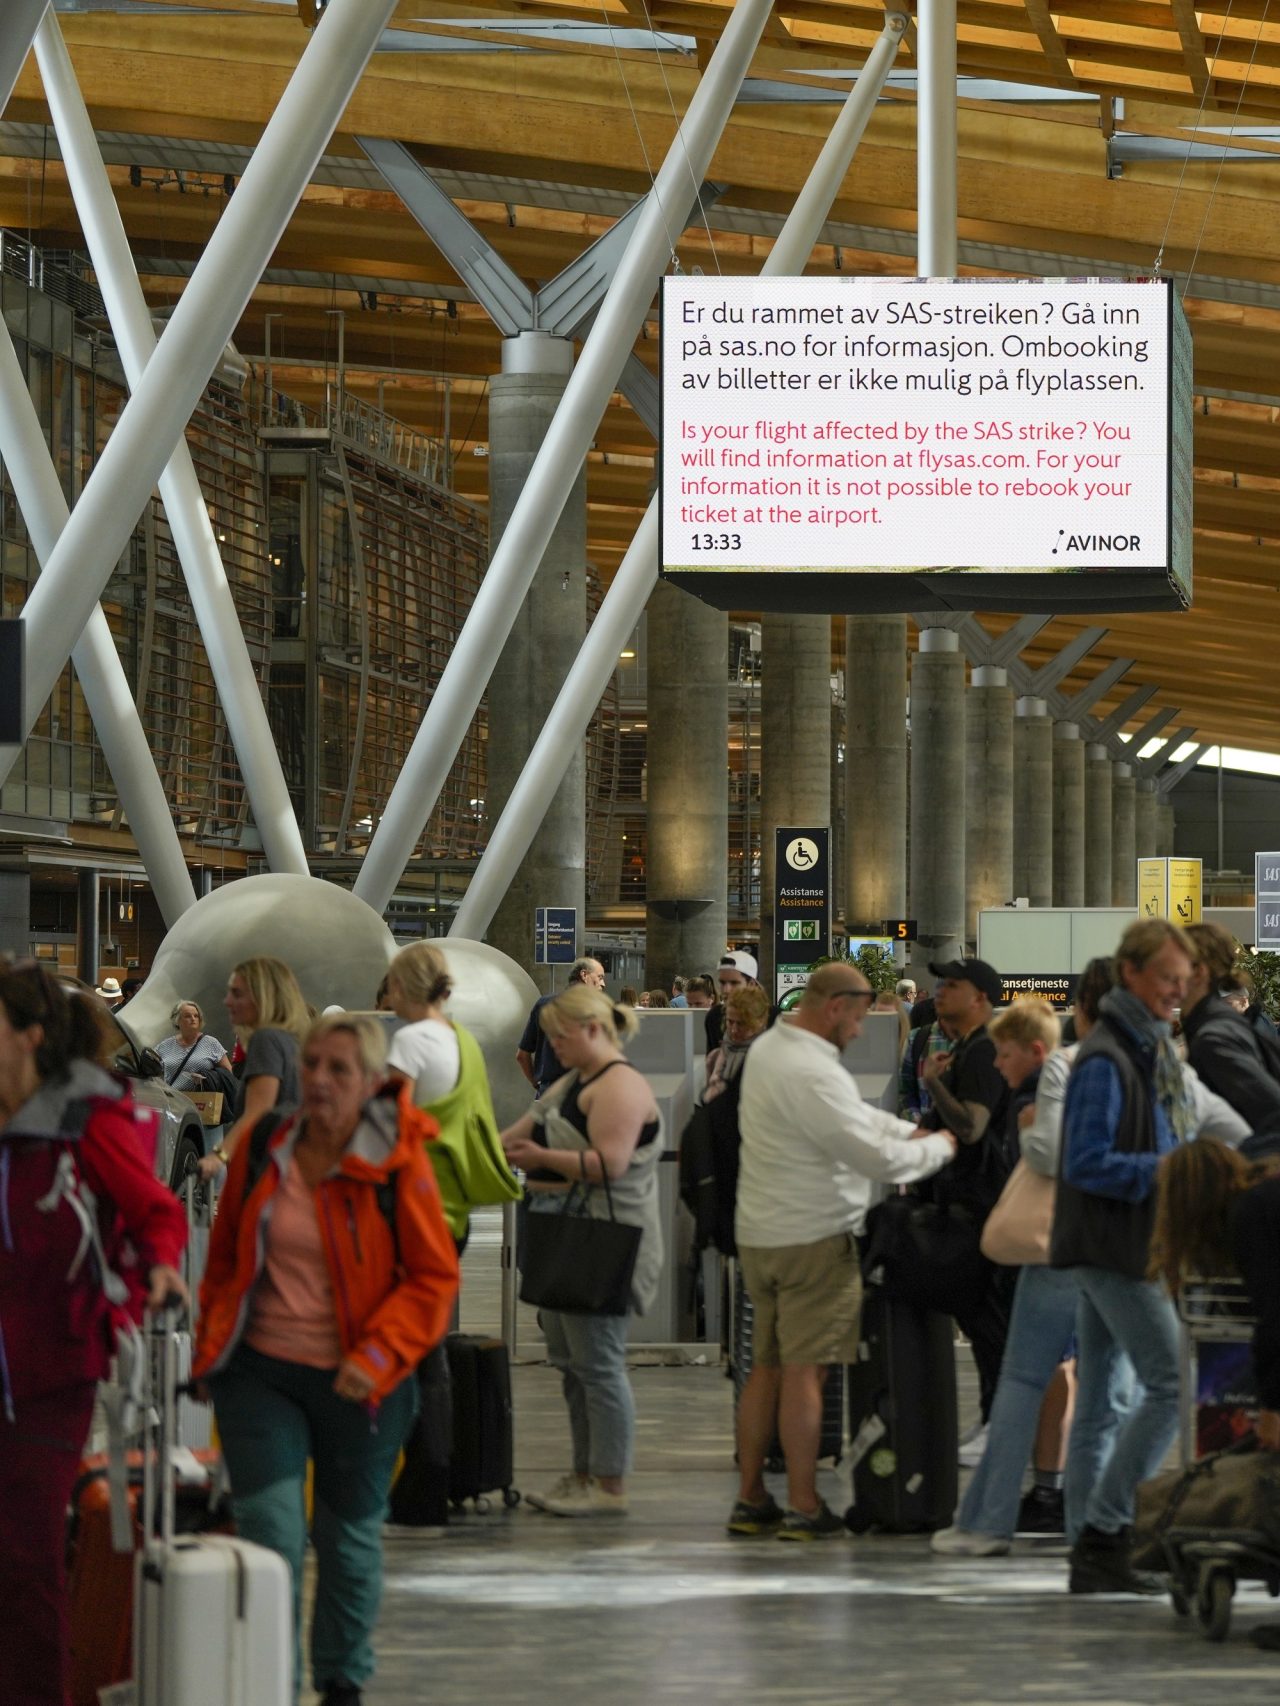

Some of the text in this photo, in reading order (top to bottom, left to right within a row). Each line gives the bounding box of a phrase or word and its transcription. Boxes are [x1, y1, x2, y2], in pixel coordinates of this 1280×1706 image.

[682, 300, 1140, 325] Er du rammet av SAS-streiken? Gå inn
[682, 333, 1149, 363] på sas.no for informasjon. Ombooking
[681, 366, 1144, 397] av billetter er ikke mulig på flyplassen.
[682, 420, 1131, 445] Is your flight affected by the SAS strike? You
[680, 448, 1122, 473] will find information at flysas.com. For your
[681, 476, 1133, 501] information it is not possible to rebook your
[680, 503, 882, 529] ticket at the airport.
[691, 533, 742, 551] 13:33
[1065, 534, 1141, 552] AVINOR
[1264, 867, 1280, 881] SAS
[780, 887, 824, 897] Assistanse
[780, 898, 824, 907] Assistance
[898, 923, 907, 938] 5
[1264, 914, 1280, 928] SAS
